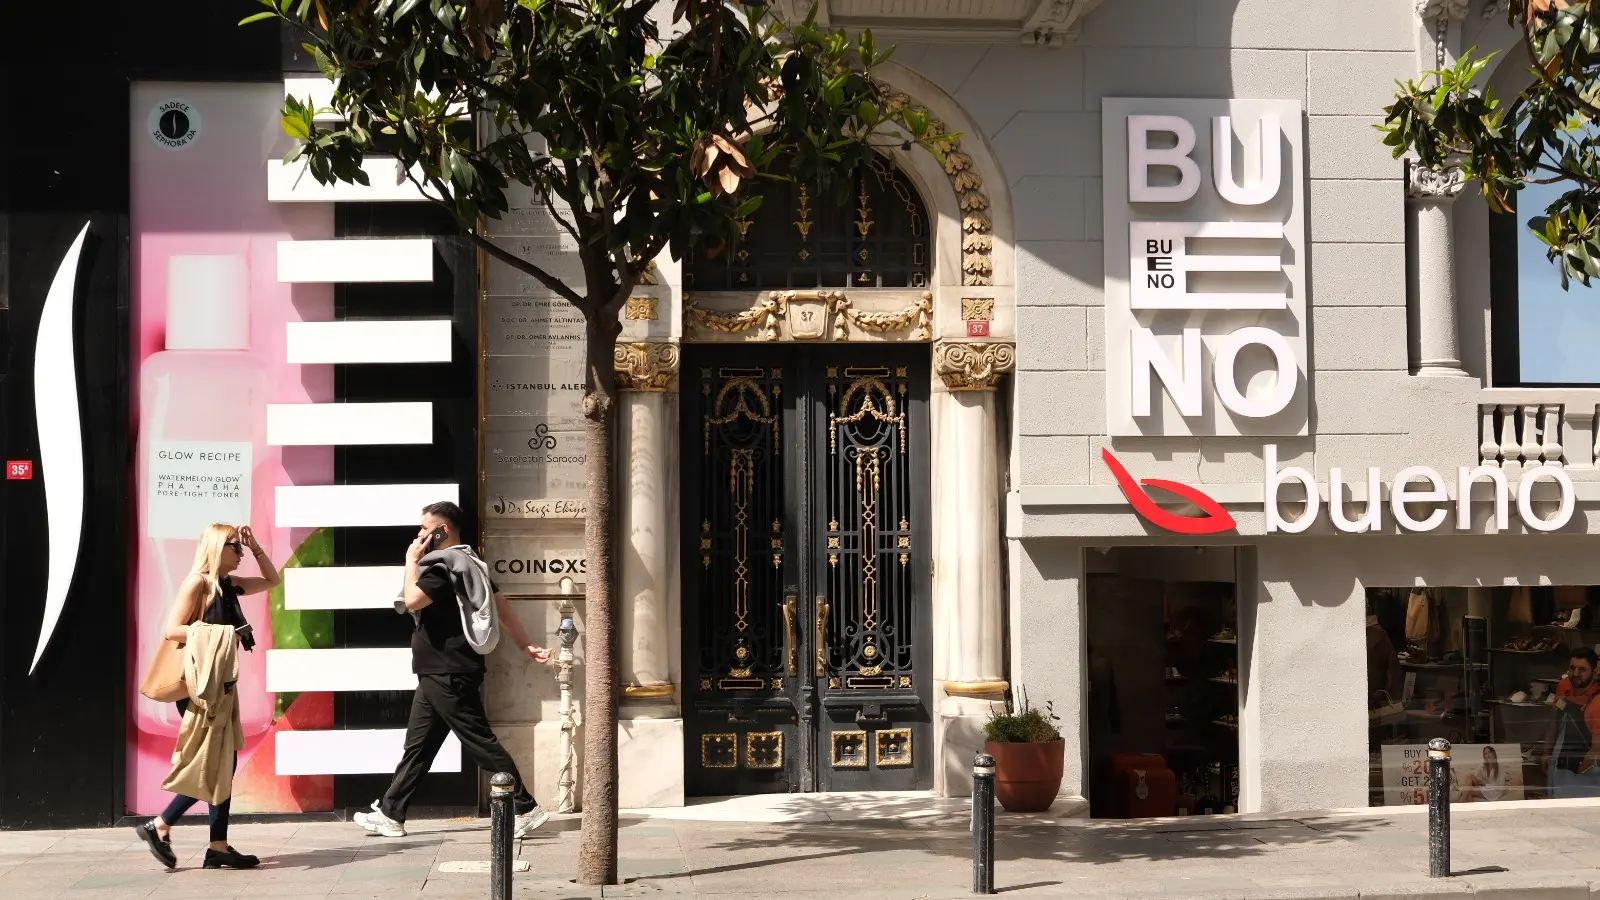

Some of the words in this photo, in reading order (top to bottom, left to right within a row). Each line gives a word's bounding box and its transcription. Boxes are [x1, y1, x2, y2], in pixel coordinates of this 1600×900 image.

[160, 101, 189, 113] SADECE
[1127, 115, 1282, 205] BU
[800, 311, 814, 322] 37
[972, 324, 983, 334] 37
[1131, 326, 1299, 418] NO
[158, 450, 194, 460] GLOW
[199, 452, 241, 462] RECIPE
[158, 474, 213, 482] WATERMELON
[157, 490, 208, 498] PORE-TIGHT
[1263, 444, 1576, 534] bueno
[525, 500, 551, 519] Sevgi
[1404, 749, 1422, 758] BUY
[1401, 776, 1420, 787] GET
[1400, 787, 1430, 805] %5
